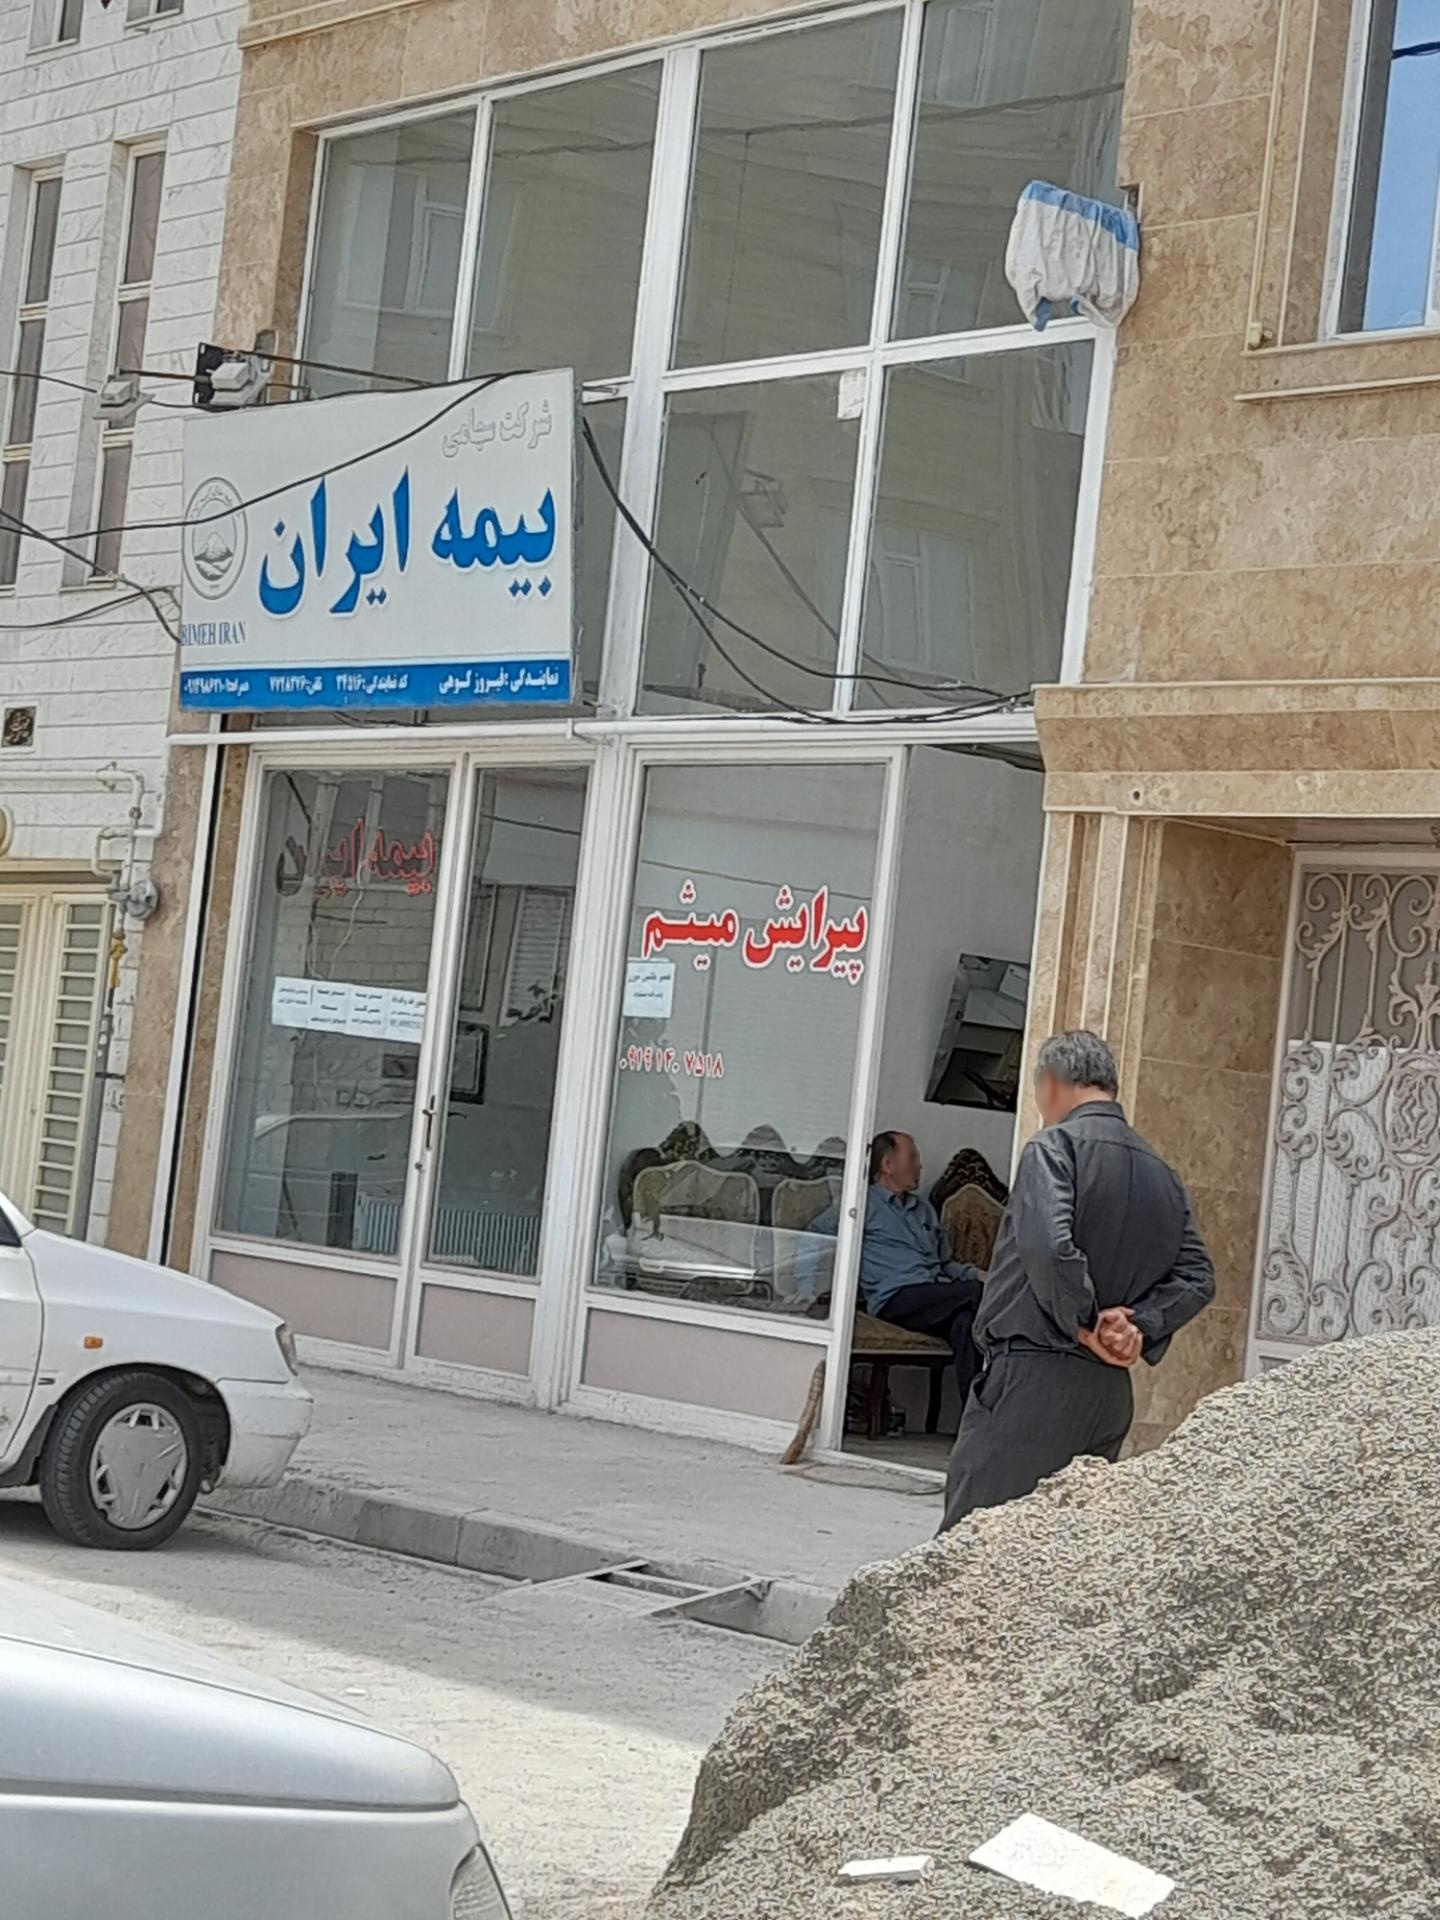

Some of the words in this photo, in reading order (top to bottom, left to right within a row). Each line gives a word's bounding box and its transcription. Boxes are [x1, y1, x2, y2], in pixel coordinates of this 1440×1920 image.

[441, 407, 495, 459] سهامی
[498, 399, 553, 450] شرکت
[258, 463, 411, 616] ایران
[431, 485, 557, 598] بیمه
[218, 621, 247, 645] IRAN
[275, 816, 365, 899] ایرن
[366, 826, 436, 897] بیمه
[641, 878, 739, 970] میثم
[742, 884, 869, 985] پیرایش
